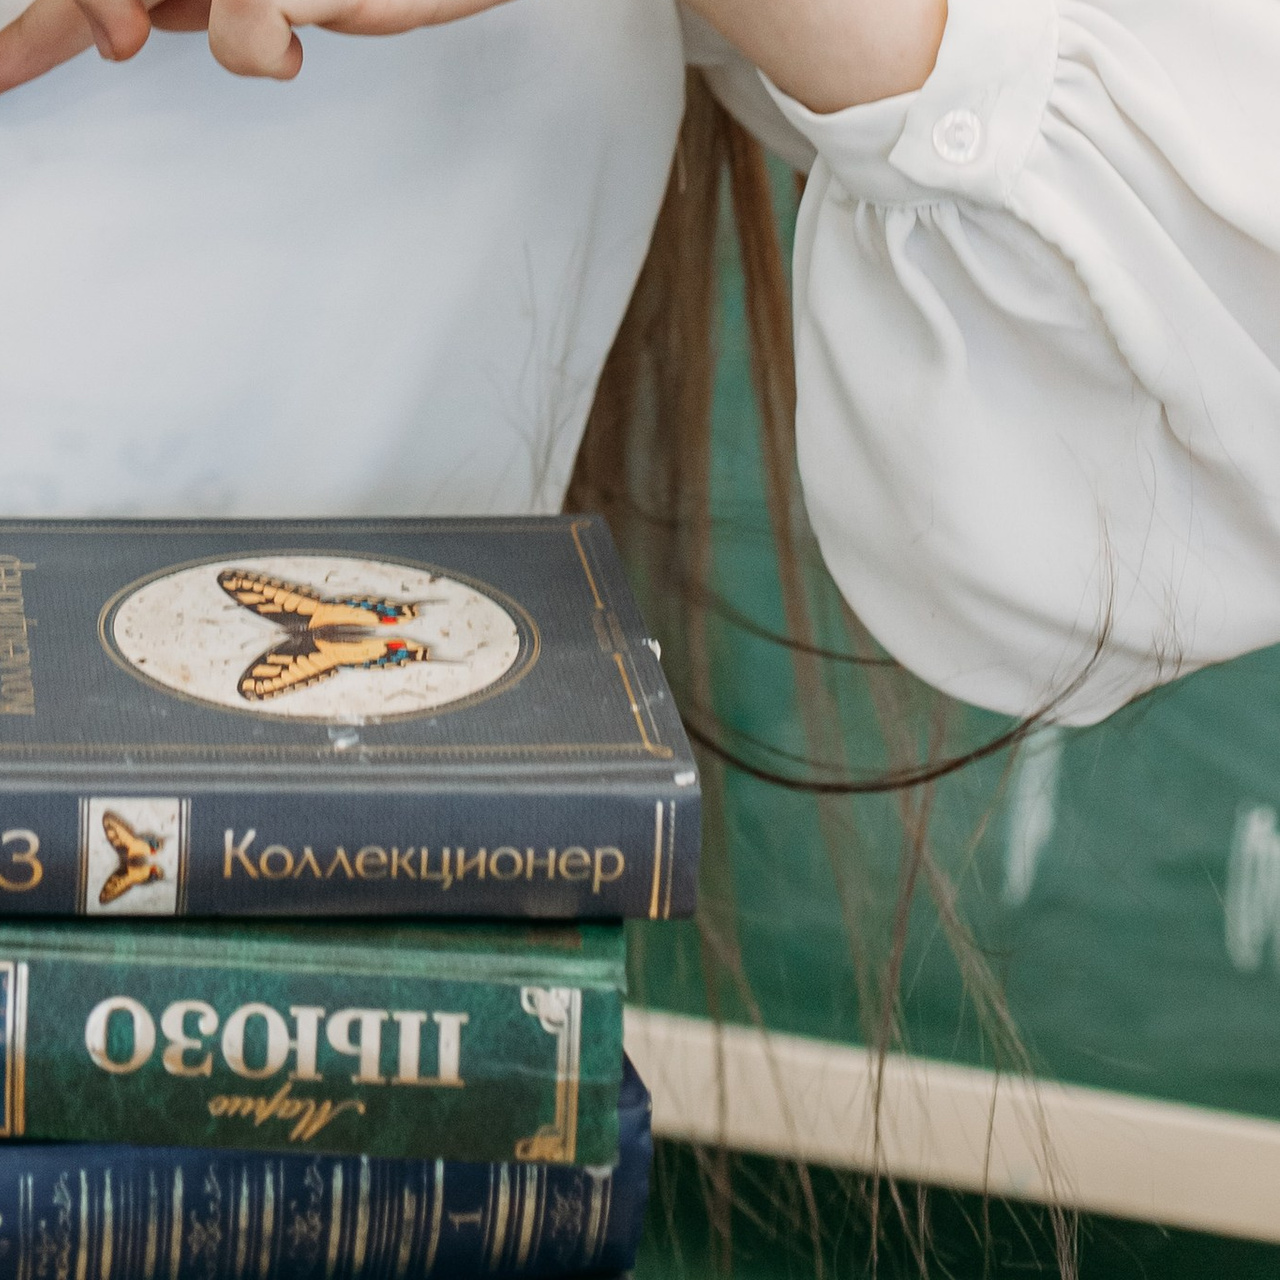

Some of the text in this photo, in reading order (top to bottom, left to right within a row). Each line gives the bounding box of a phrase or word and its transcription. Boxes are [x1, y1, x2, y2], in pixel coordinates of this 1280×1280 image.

[222, 828, 626, 894] Коллекционер
[84, 995, 470, 1088] ПЬЮЗО
[208, 1081, 366, 1141] Марио
